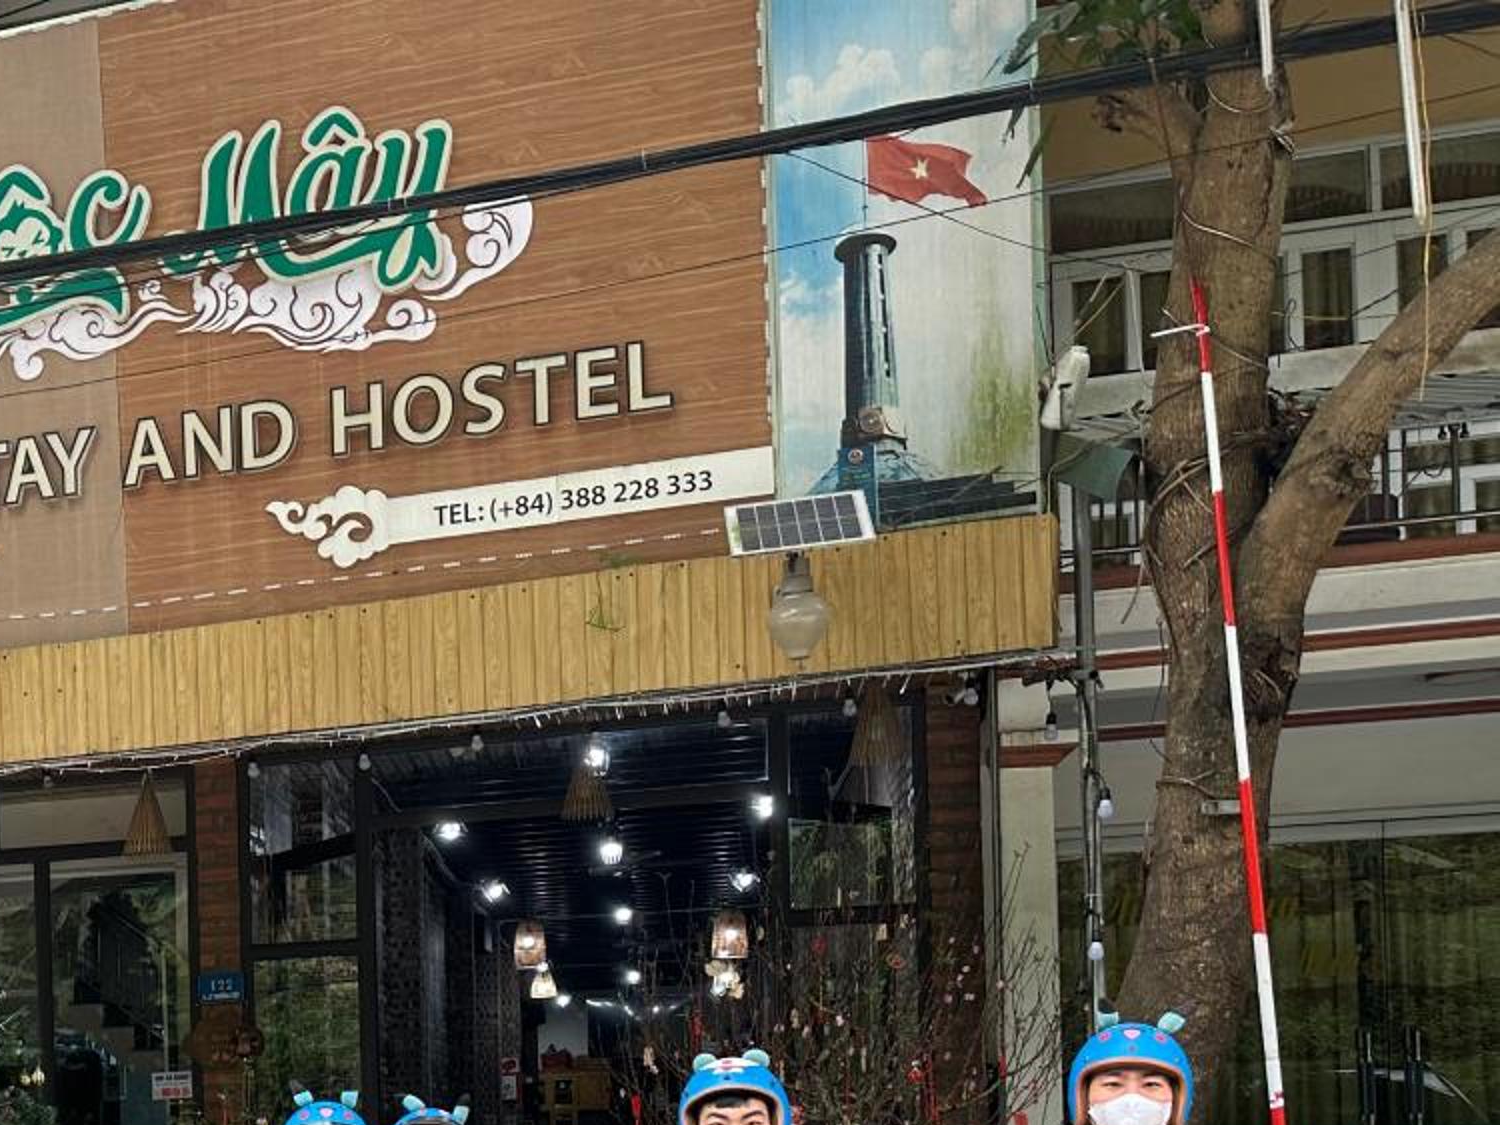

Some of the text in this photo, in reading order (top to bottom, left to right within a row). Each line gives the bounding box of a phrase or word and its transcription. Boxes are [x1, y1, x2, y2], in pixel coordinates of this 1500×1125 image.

[162, 106, 452, 290] Mây
[123, 400, 295, 487] AND
[330, 341, 673, 455] HOSTEL
[434, 470, 713, 526] TEL: (+84) 388 228 333
